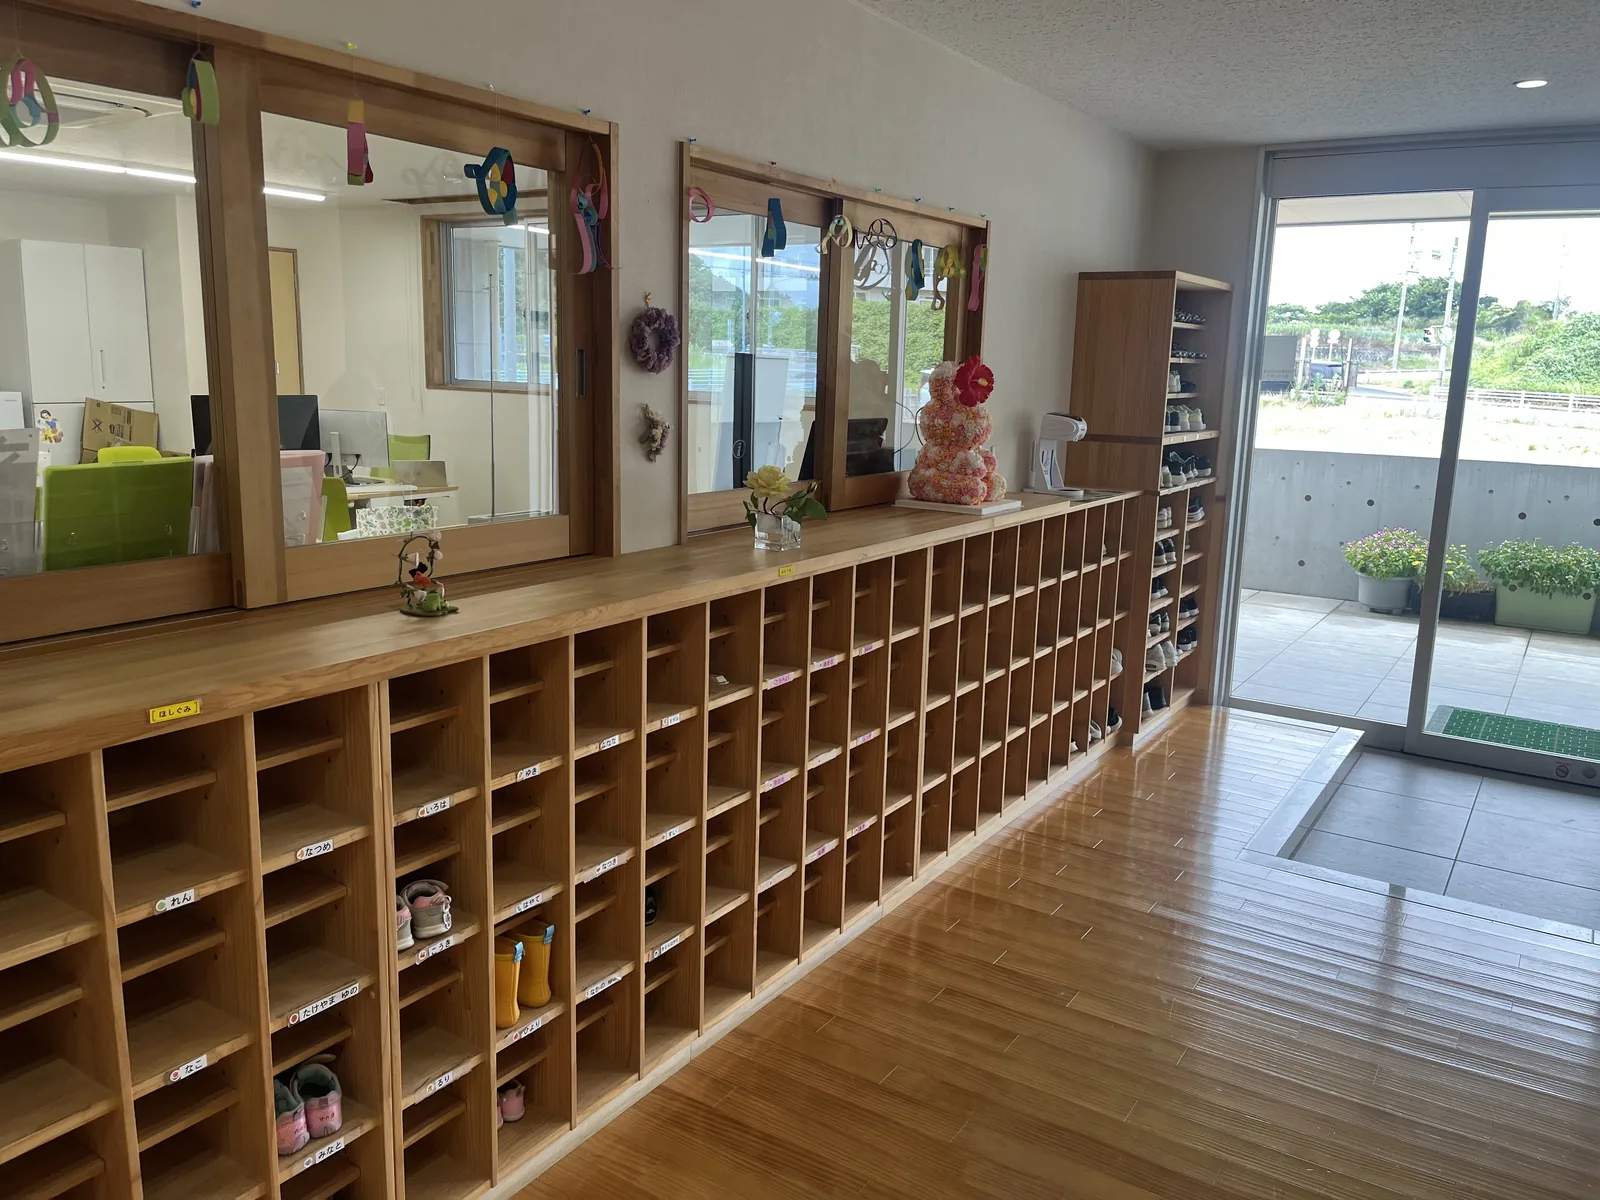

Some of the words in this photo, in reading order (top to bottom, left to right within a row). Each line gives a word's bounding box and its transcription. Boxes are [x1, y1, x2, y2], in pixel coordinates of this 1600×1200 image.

[159, 705, 191, 719] ほしぐみ
[425, 800, 446, 814] いろは
[305, 842, 331, 857] なつめ
[170, 893, 192, 907] れん
[431, 939, 451, 955] こうき
[303, 995, 335, 1018] たけやま
[341, 986, 358, 999] ゆの
[185, 1059, 203, 1074] なこ
[438, 1074, 450, 1087] るり
[318, 1142, 341, 1160] みなと
